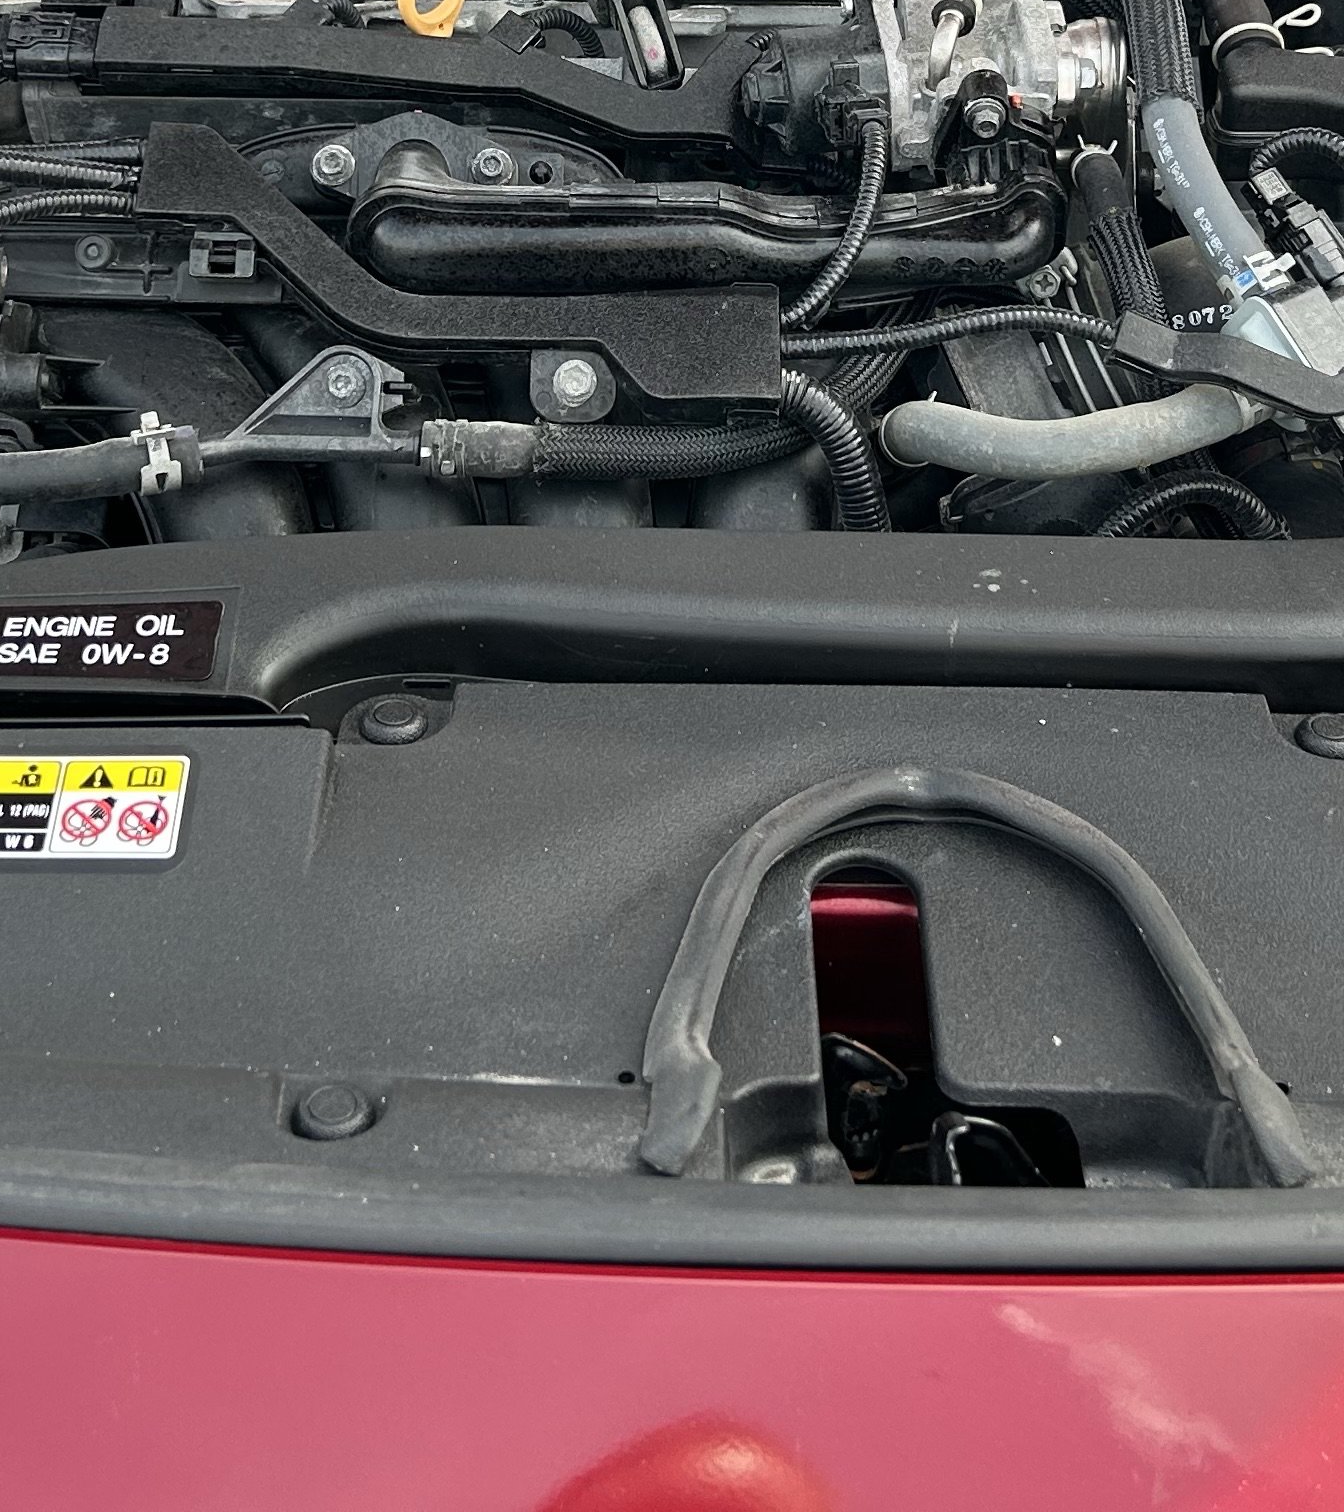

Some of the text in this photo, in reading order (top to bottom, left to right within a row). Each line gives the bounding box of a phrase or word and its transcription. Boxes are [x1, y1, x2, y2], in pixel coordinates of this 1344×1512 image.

[2, 613, 185, 638] ENGINE OIL
[81, 642, 171, 666] 0W-8
[5, 834, 21, 849] W
